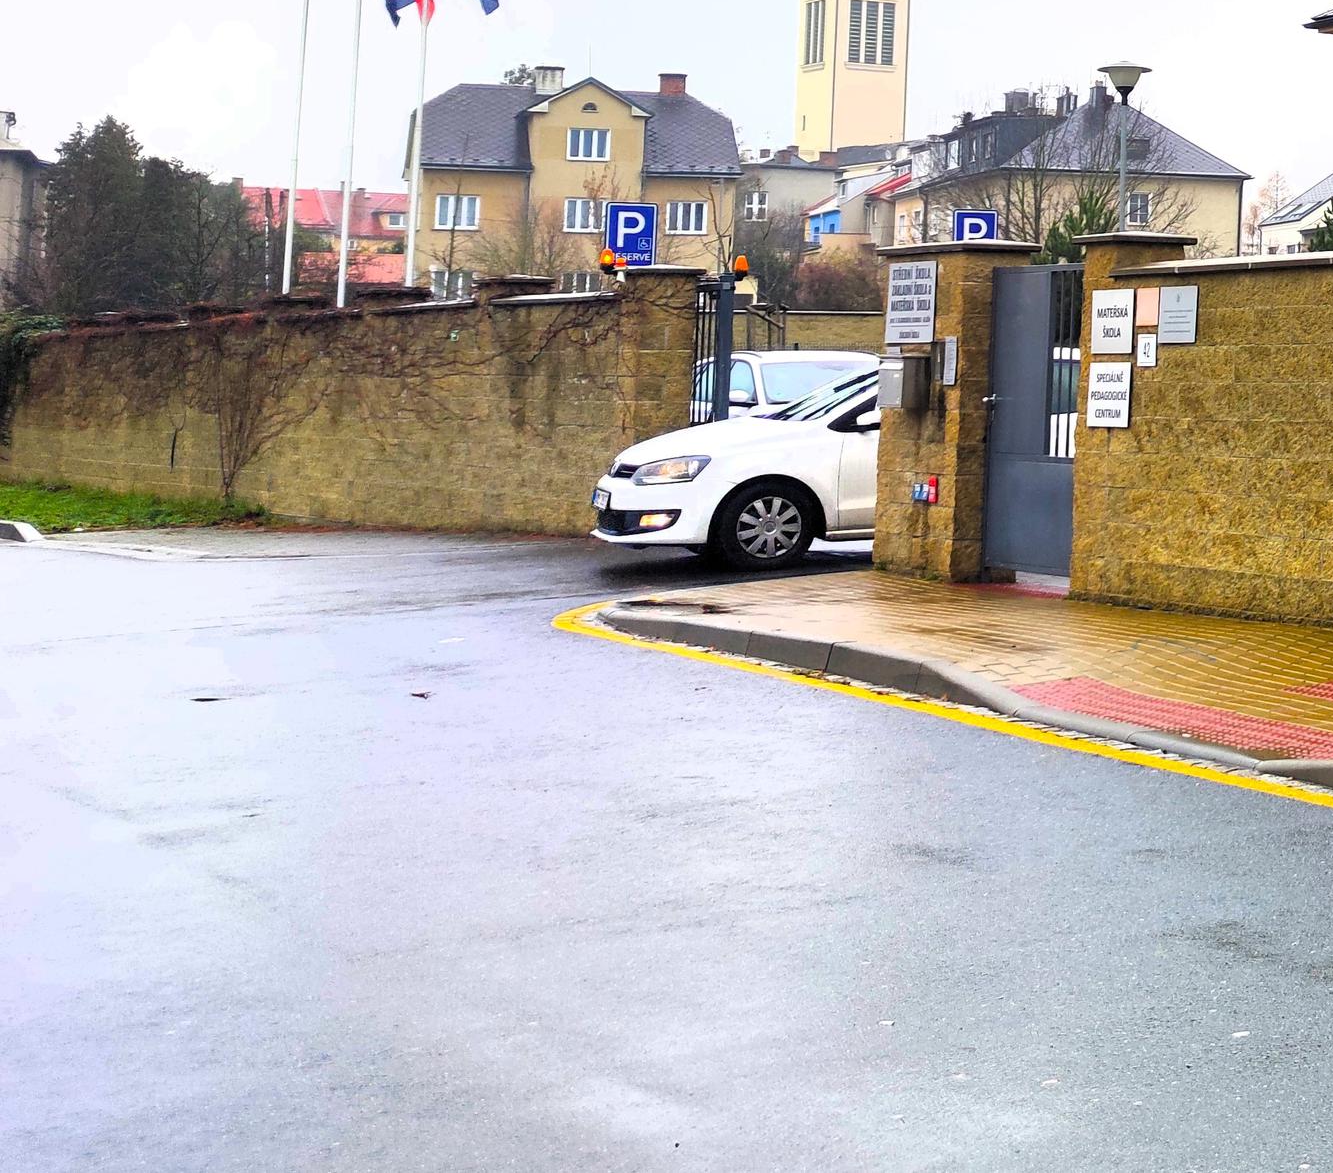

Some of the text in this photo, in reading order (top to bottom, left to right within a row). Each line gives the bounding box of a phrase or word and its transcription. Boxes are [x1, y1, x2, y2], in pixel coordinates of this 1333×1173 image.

[616, 211, 646, 248] P
[963, 217, 988, 241] P
[615, 251, 651, 261] ESERVÉ
[1097, 304, 1128, 318] MATEŘSKÁ
[1102, 325, 1121, 338] ŠKOLA
[1143, 342, 1151, 358] 42
[1090, 388, 1127, 401] PEDAGOGICKÉ
[1095, 408, 1122, 419] CENTRUM
